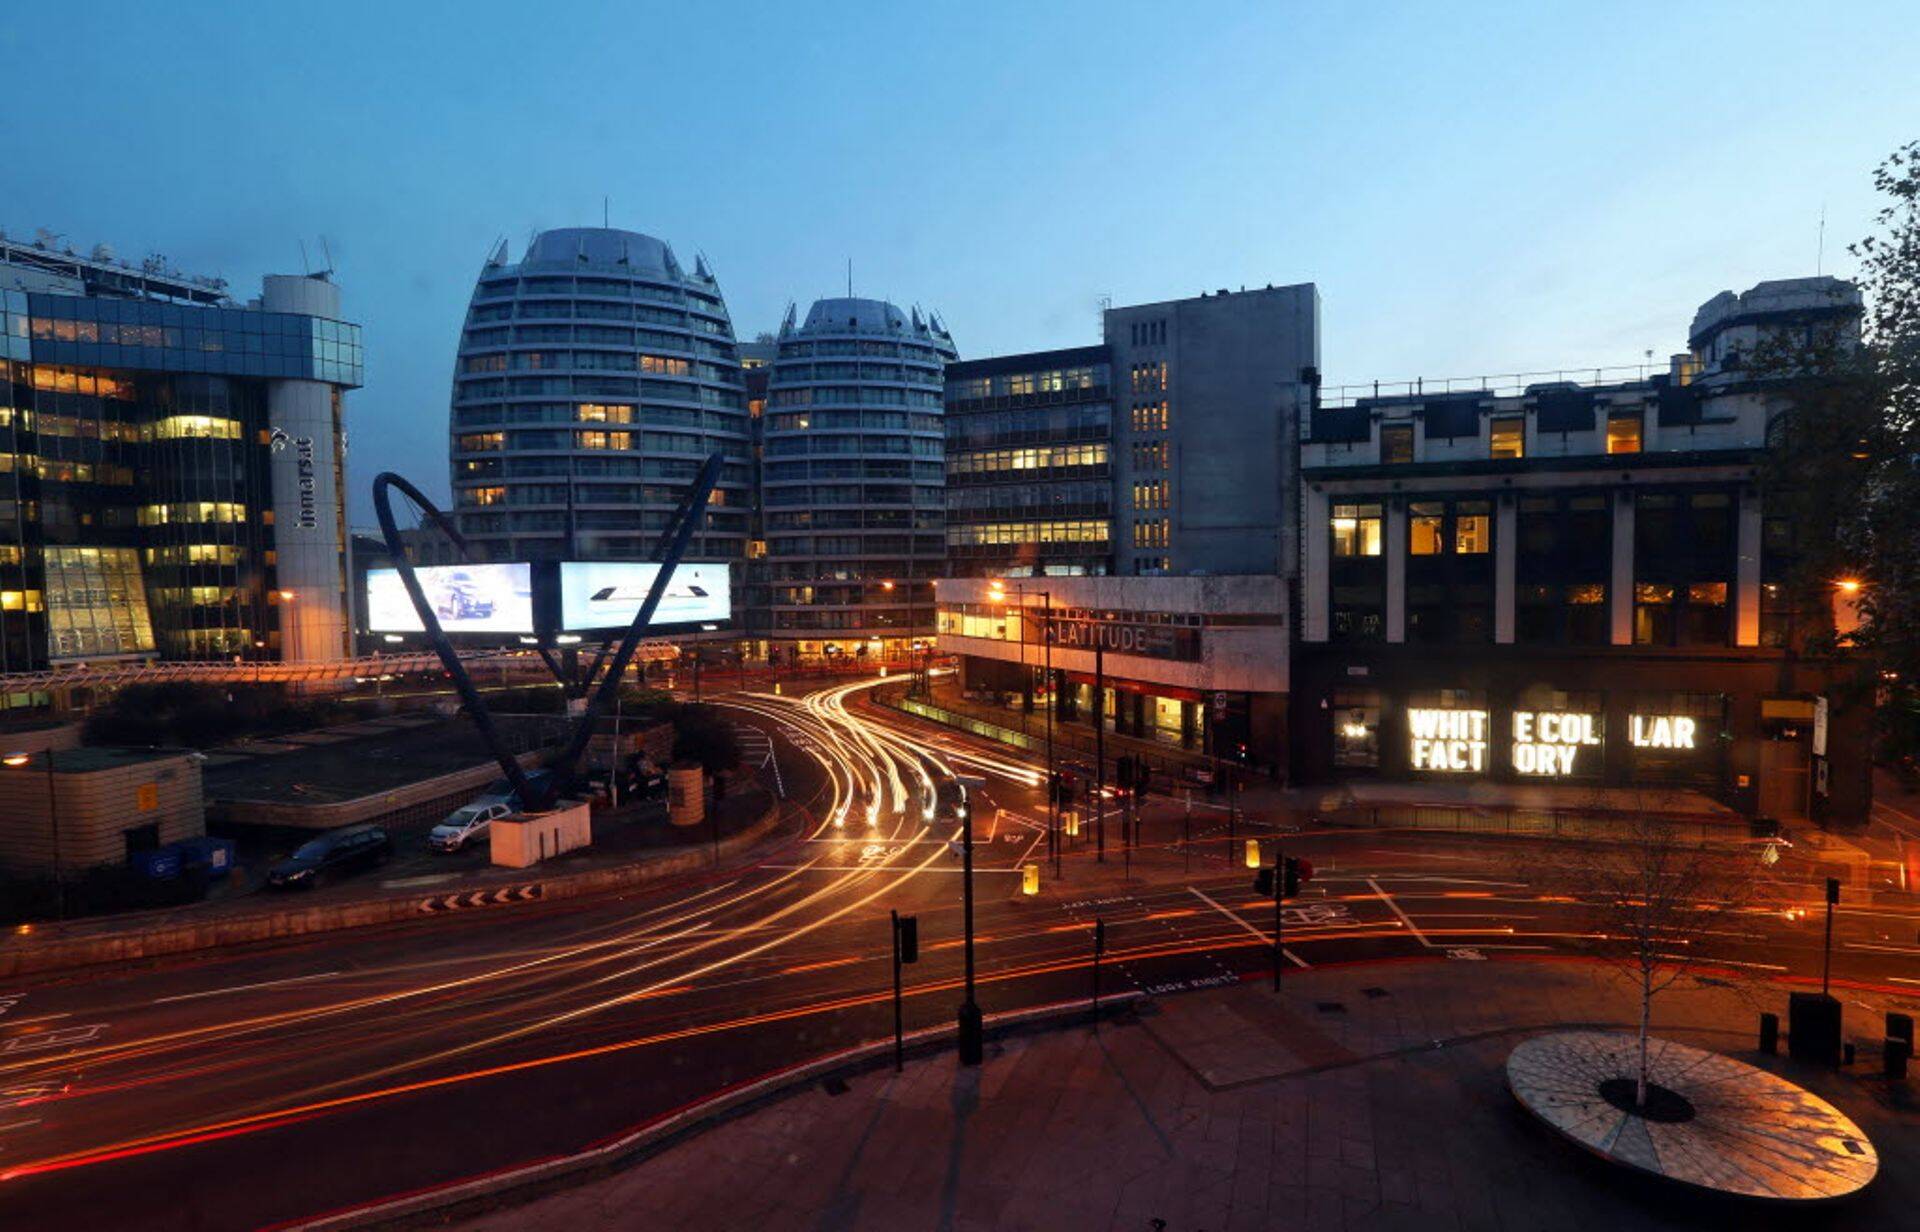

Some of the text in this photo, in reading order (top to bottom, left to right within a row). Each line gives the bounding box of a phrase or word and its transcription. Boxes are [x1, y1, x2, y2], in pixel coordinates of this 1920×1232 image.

[294, 437, 316, 529] inmarsat
[1057, 620, 1148, 651] LATITUDE
[1408, 708, 1488, 740] WHIT
[1630, 715, 1697, 748] LAR
[1411, 740, 1578, 775] FACT ORY
